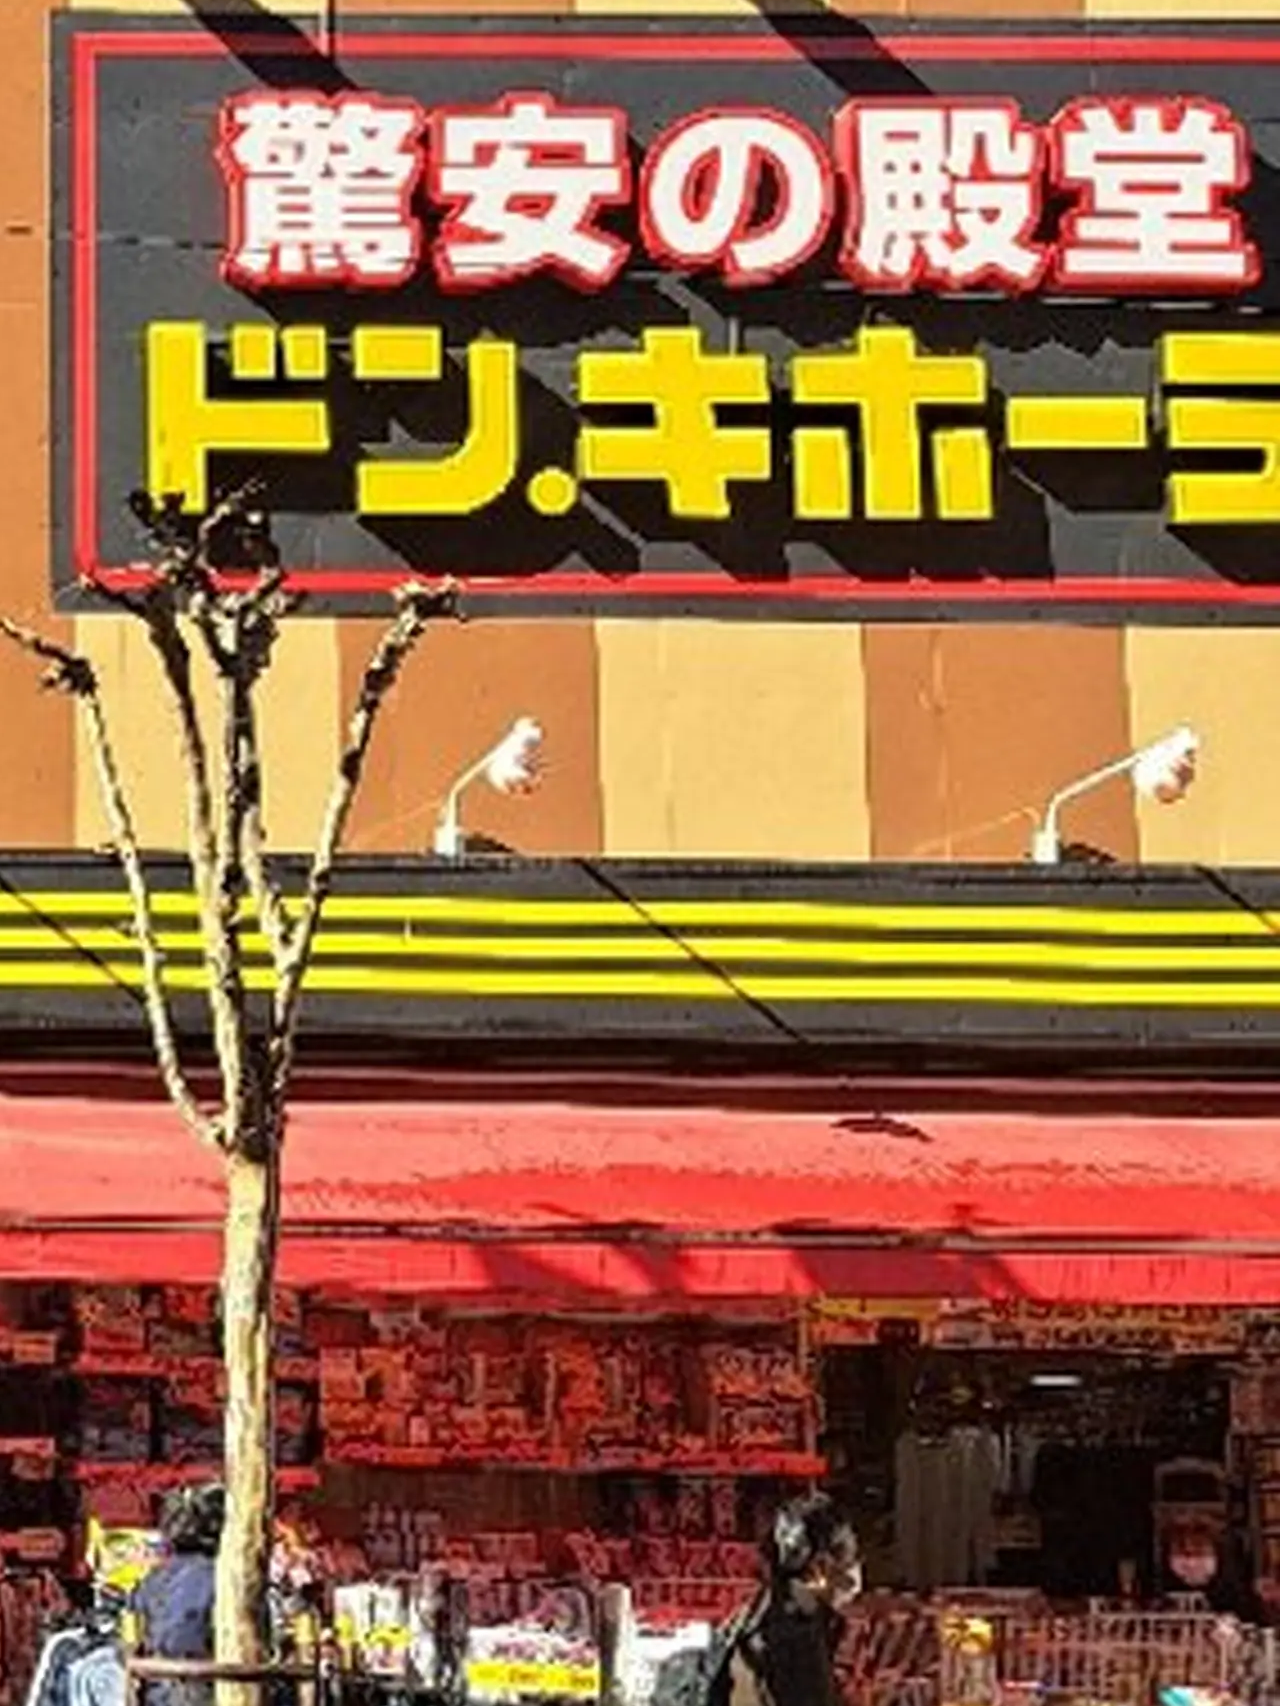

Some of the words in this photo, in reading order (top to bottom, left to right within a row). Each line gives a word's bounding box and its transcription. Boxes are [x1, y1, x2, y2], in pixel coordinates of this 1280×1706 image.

[224, 90, 1259, 291] 驚安の殿堂
